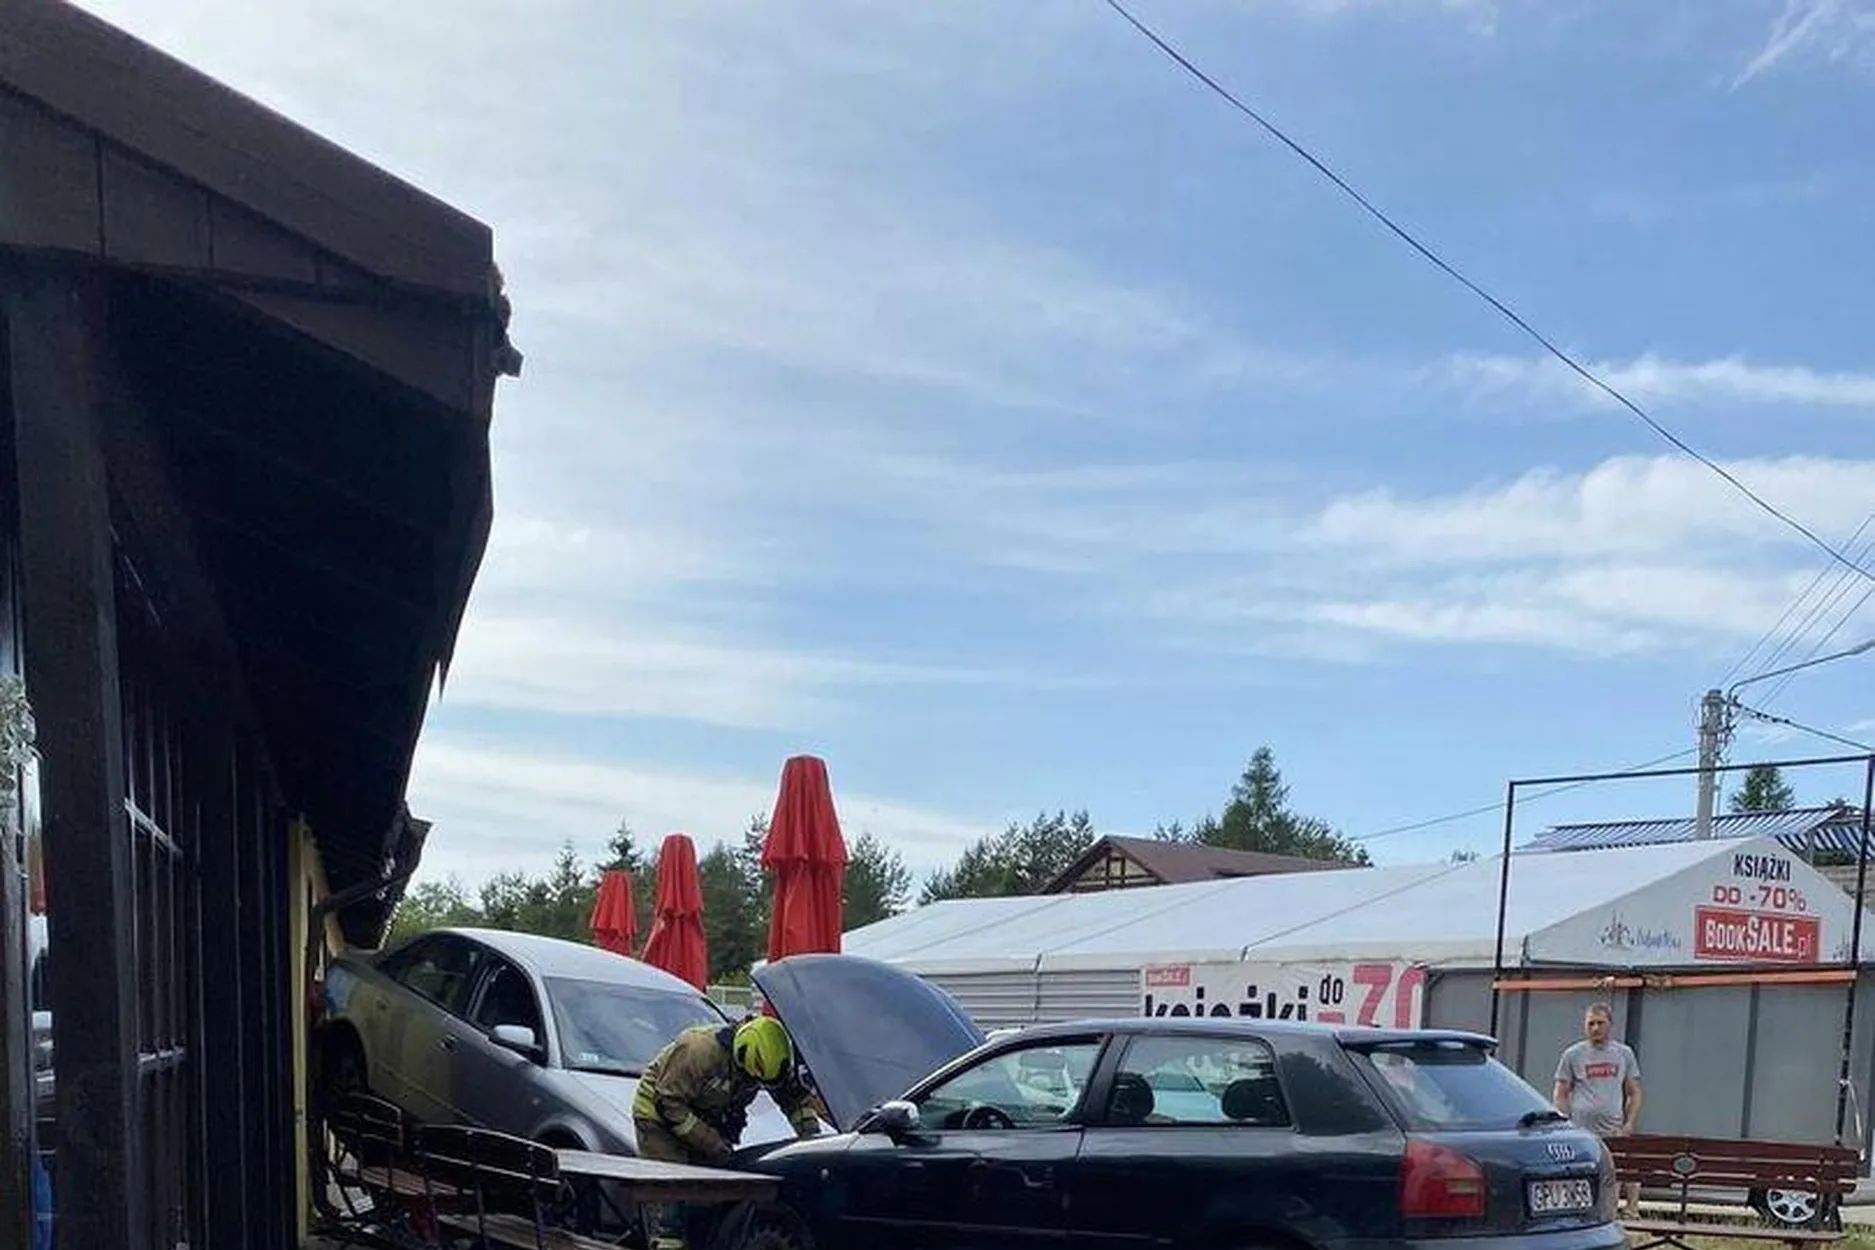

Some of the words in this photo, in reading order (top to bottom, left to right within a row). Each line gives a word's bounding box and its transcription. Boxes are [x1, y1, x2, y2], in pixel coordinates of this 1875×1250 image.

[1733, 853, 1791, 882] KSIĄŻKI
[1713, 885, 1741, 904] DO
[1749, 886, 1807, 912] -70%
[1319, 974, 1343, 1005] do
